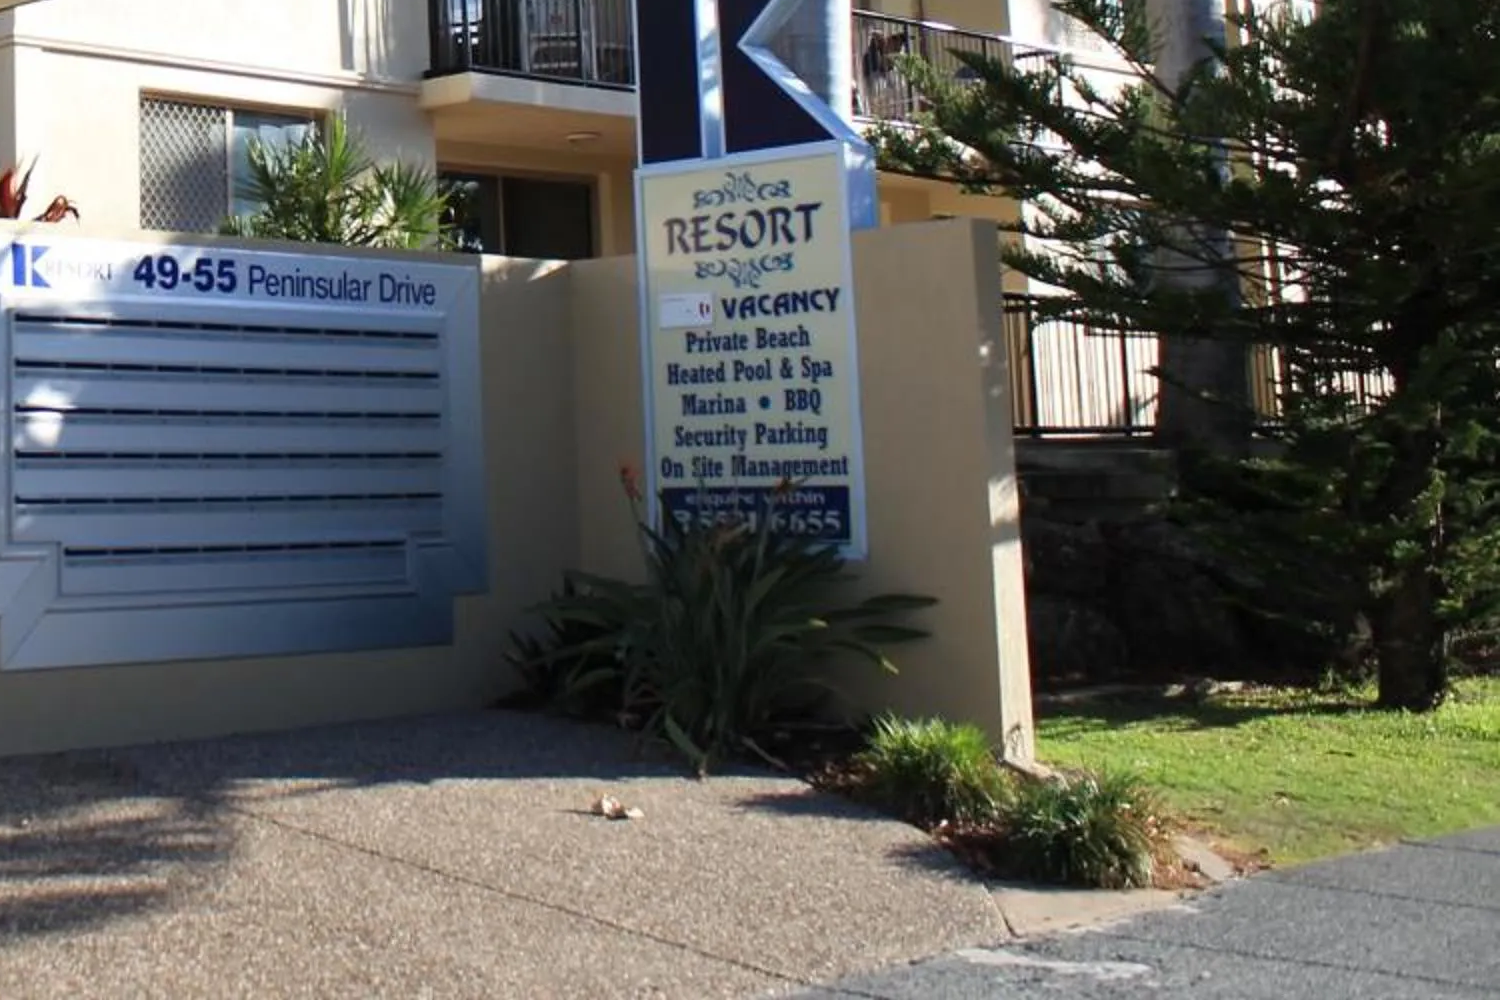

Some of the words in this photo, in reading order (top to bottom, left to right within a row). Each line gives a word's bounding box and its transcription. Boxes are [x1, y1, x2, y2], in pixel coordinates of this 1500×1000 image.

[664, 202, 823, 255] RESORT
[11, 242, 51, 288] K
[134, 255, 237, 293] 49-55
[248, 265, 372, 302] Peninsular
[378, 273, 436, 306] Drive
[720, 287, 840, 319] VACANCY
[685, 330, 748, 353] Private
[755, 324, 811, 349] Beach
[667, 361, 726, 385] Heated
[733, 357, 772, 382] Pool
[779, 356, 793, 380] &
[801, 355, 833, 384] Spa
[681, 392, 746, 416] Marina
[784, 388, 822, 415] BBQ
[674, 424, 747, 452] Security
[754, 421, 828, 450] Parking
[661, 456, 684, 479] On
[692, 455, 723, 478] Site
[731, 453, 849, 480] Management
